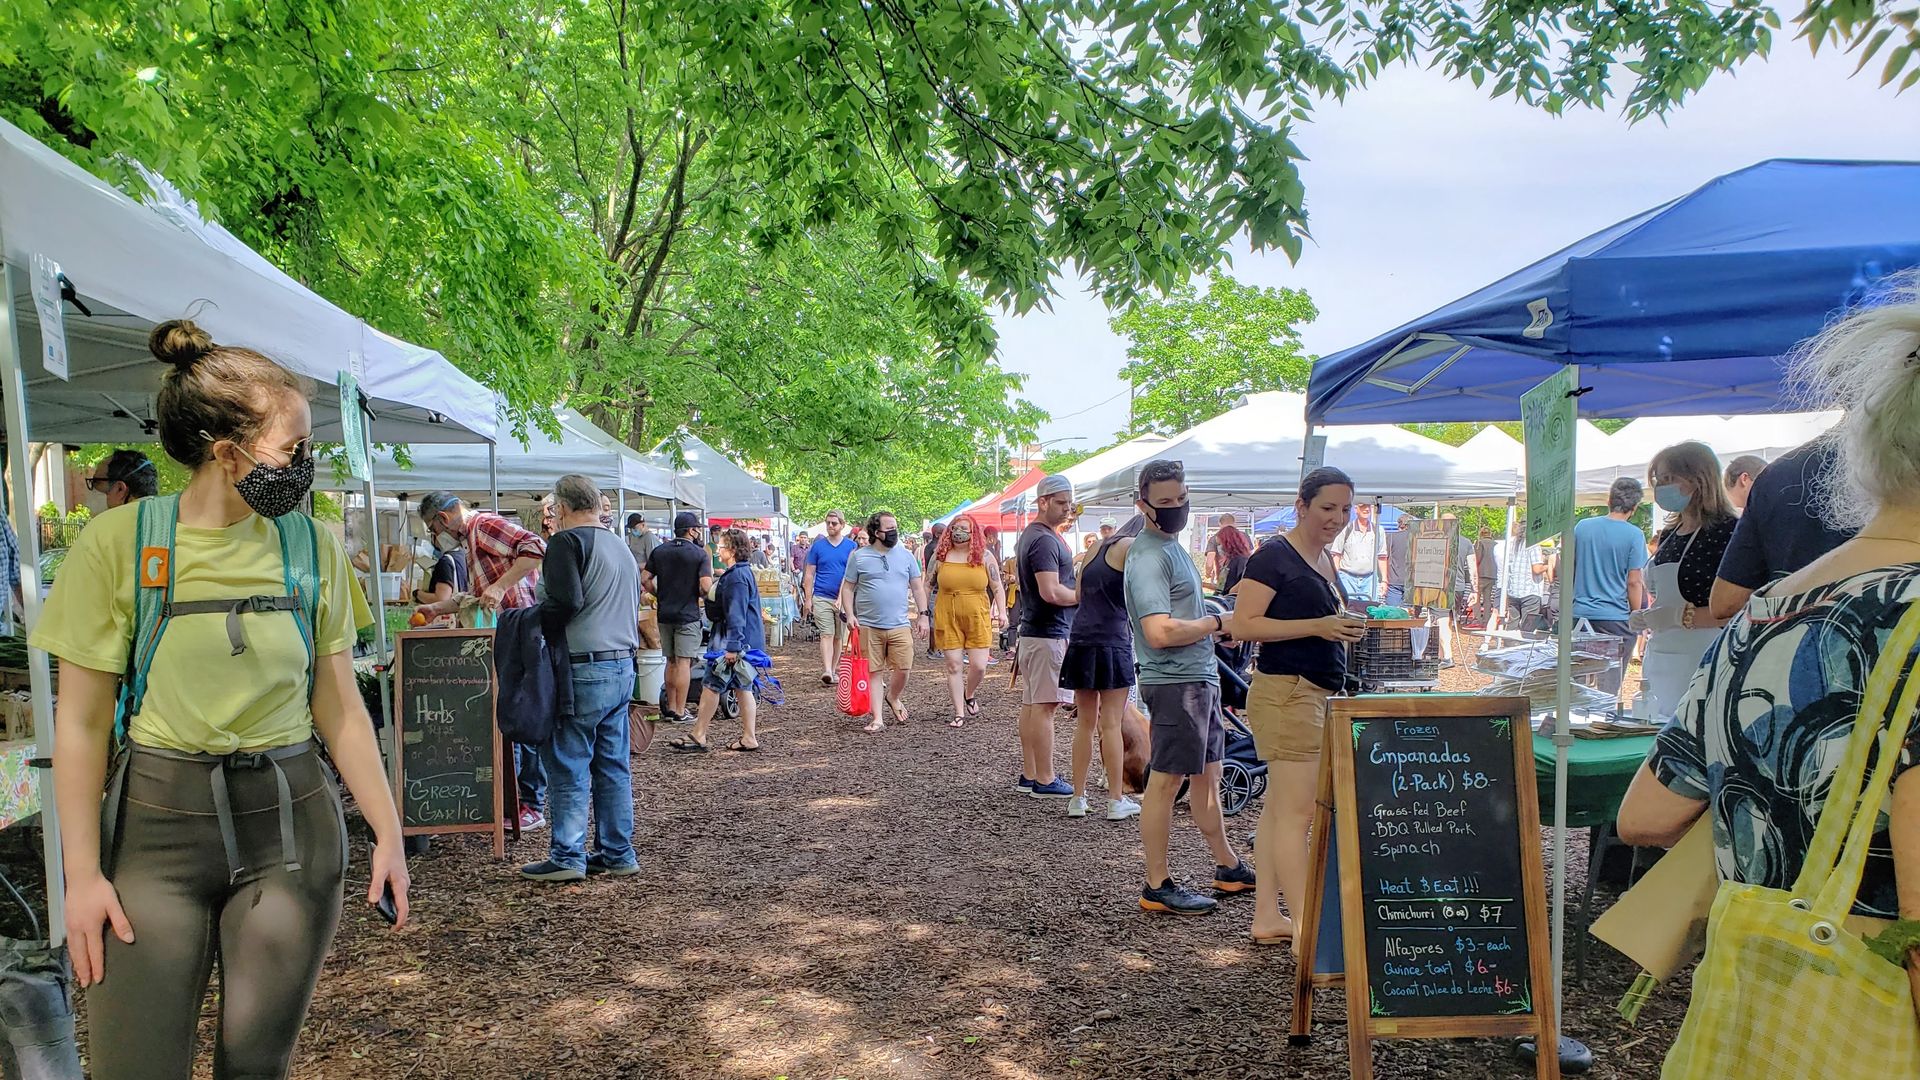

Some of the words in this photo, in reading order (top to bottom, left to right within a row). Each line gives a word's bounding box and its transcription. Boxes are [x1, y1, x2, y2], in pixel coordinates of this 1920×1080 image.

[416, 694, 456, 724] Herbs
[1395, 720, 1440, 735] Frozen
[1370, 741, 1471, 773] Empanadas
[1392, 769, 1455, 798] (2-Pack)
[1434, 800, 1467, 817] Beef
[1413, 820, 1442, 834] Pulled
[1446, 820, 1476, 836] Pork
[1380, 877, 1415, 895] Heat
[1378, 904, 1435, 920] Chimichurri
[1480, 904, 1502, 923] $7
[1385, 937, 1444, 961] Alfajores
[1487, 936, 1512, 951] each
[1384, 962, 1424, 976] Quince
[1425, 960, 1453, 975] tart
[1382, 980, 1420, 997] Coconut
[1423, 982, 1449, 997] Dulce
[1450, 980, 1464, 995] de
[1468, 980, 1494, 994] Leche
